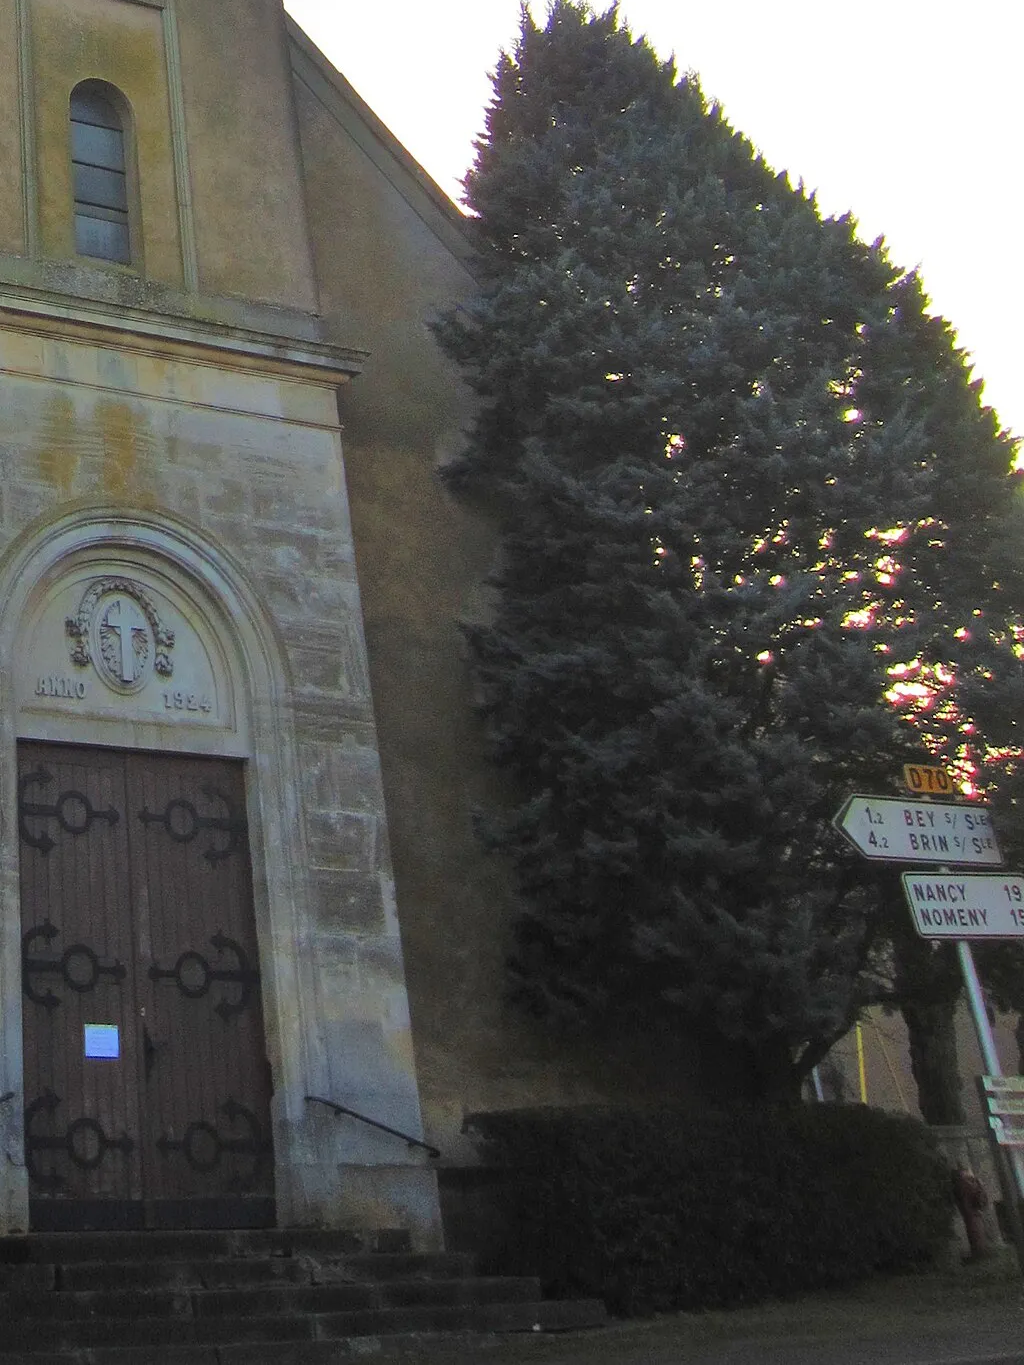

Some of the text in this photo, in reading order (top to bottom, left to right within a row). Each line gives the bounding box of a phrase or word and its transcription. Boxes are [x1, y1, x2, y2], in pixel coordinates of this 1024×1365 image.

[35, 677, 86, 700] ANNO
[909, 767, 949, 789] D70
[904, 809, 936, 827] BEY
[910, 833, 950, 852] BRIN
[913, 884, 1022, 902] NANCY 19
[920, 908, 988, 926] NOMENY
